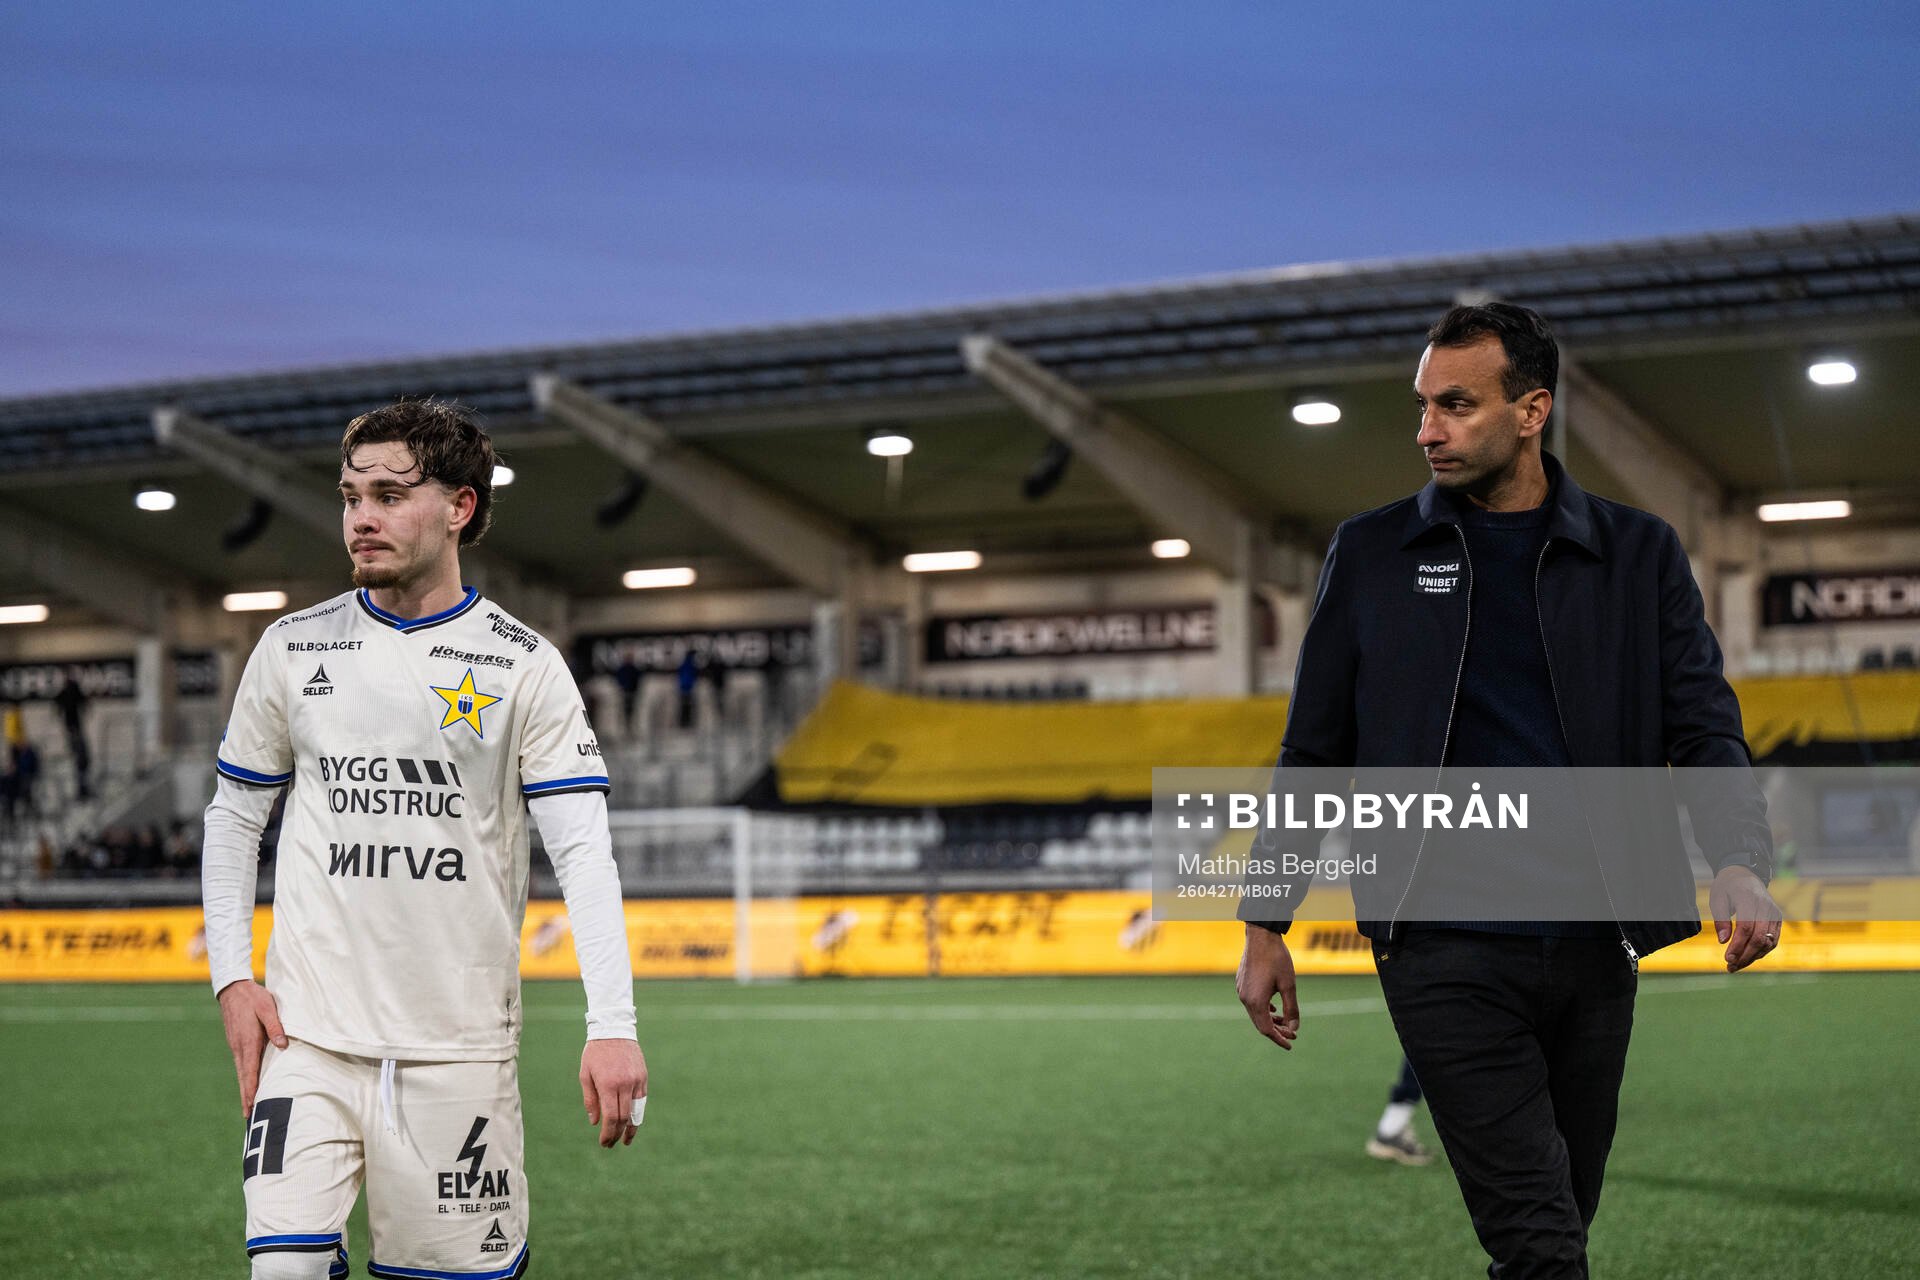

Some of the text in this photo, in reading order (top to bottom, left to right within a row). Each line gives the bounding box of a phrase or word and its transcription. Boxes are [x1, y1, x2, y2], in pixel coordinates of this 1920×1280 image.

[1418, 563, 1460, 573] AVOKI
[1418, 576, 1458, 587] UNIBET
[291, 603, 346, 623] Ramudden
[287, 641, 364, 652] BILBOLAGET
[429, 645, 516, 667] HÖGBERGS
[303, 686, 334, 696] SELECT
[319, 756, 388, 782] BYGG
[328, 787, 465, 818] ONSTRUC
[328, 842, 467, 881] mirva
[438, 1201, 511, 1213] EL TELE DATA
[480, 1242, 509, 1252] SELECT
